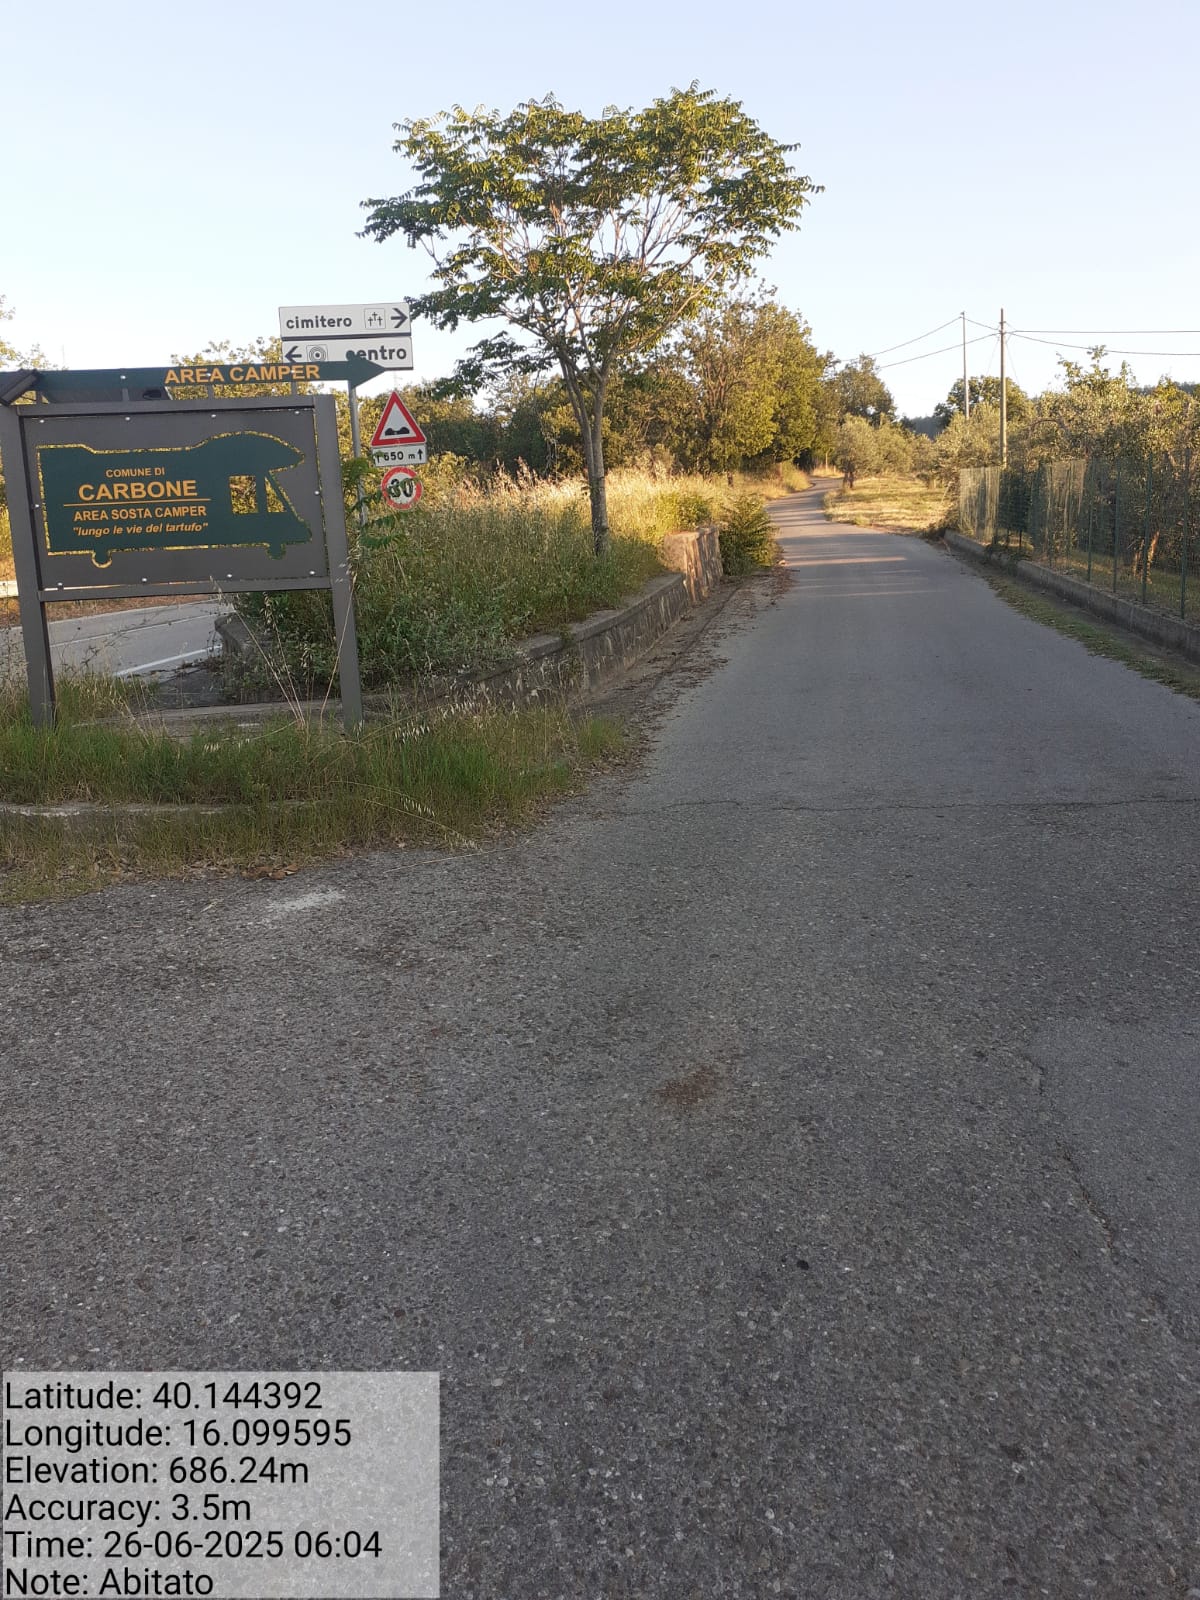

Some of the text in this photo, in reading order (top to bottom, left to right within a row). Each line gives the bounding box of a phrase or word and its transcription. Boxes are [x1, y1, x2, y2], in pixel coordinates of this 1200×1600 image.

[286, 315, 352, 329] cimitero
[165, 364, 320, 384] AREA CAMPER
[383, 451, 404, 461] 650
[105, 467, 165, 478] COMUNE DI
[78, 480, 198, 501] CARBONE
[74, 505, 207, 522] AREA SOSTA CAMPER
[73, 522, 208, 538] "lungo le vie del tartufo"
